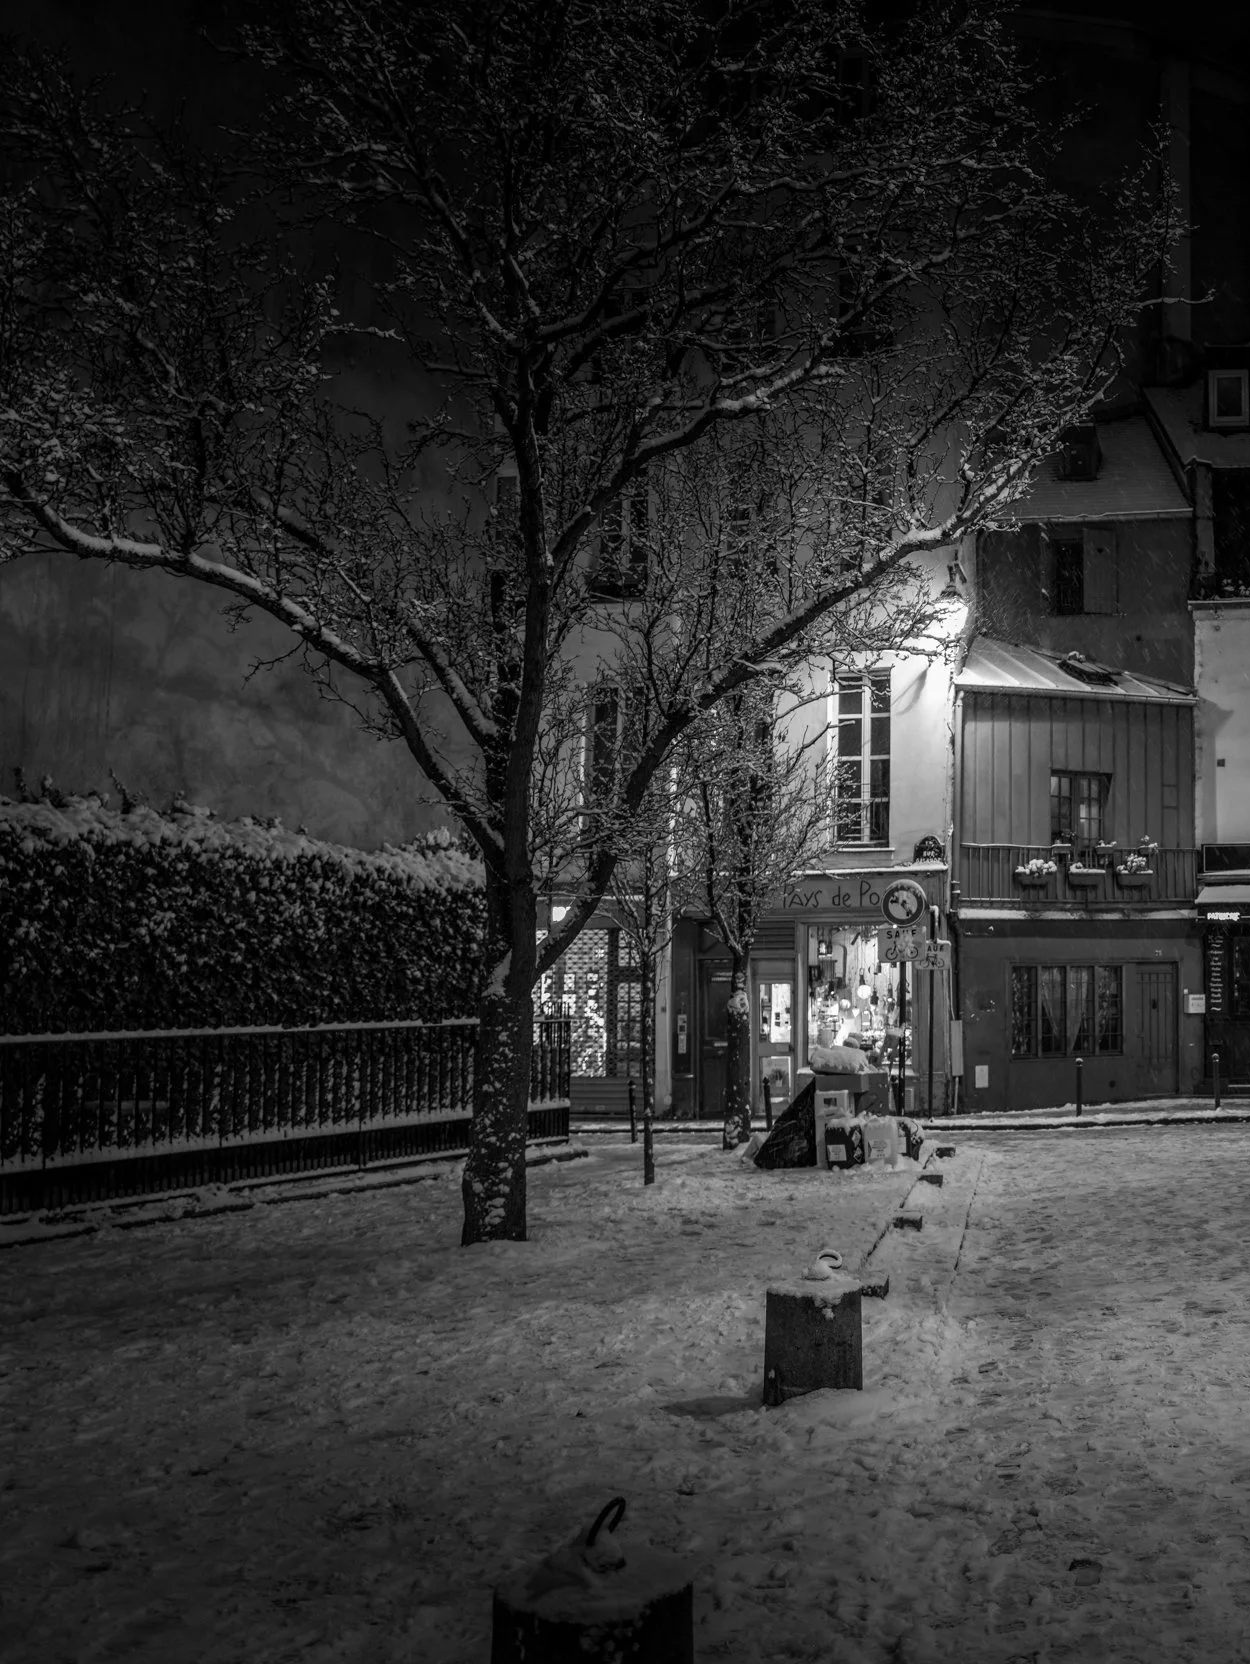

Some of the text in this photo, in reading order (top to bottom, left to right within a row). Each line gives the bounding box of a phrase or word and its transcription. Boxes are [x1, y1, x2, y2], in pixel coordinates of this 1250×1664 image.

[832, 886, 850, 907] de
[886, 929, 917, 939] SAF
[927, 944, 944, 952] AUF
